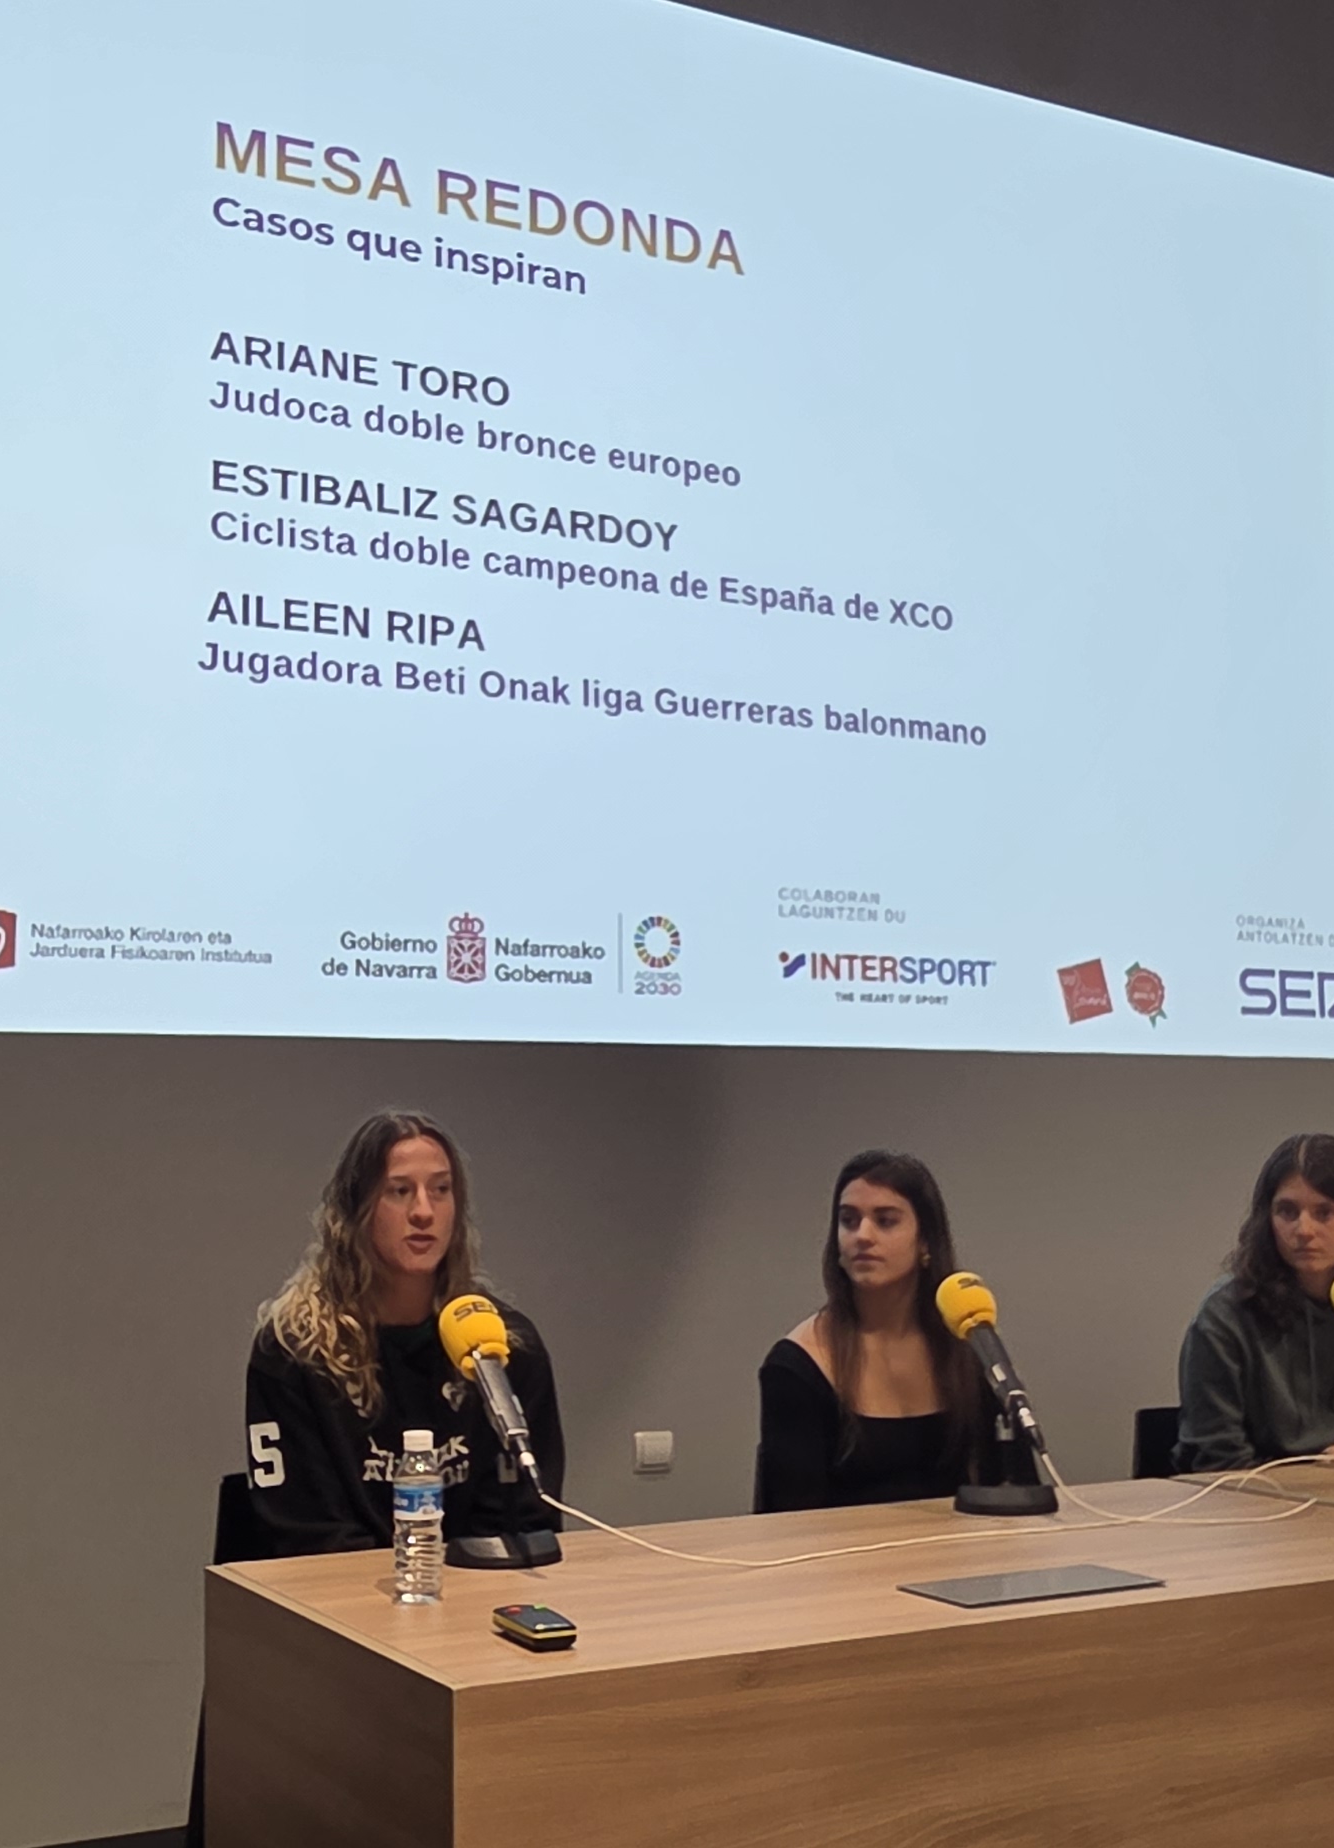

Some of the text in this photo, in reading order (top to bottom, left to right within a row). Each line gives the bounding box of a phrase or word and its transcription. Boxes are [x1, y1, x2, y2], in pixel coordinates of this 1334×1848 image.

[215, 120, 745, 276] MESA REDONDA
[212, 196, 586, 296] Casos que inspiran
[209, 331, 510, 407] ARIANE TORO
[208, 380, 741, 488] Judoca doble bronce europeo
[212, 459, 679, 553] ESTIBALIZ SAGARDOY
[210, 510, 954, 631] Ciclista doble campeona de España de XCO
[206, 590, 486, 652] AILEEN RIPA
[197, 641, 987, 746] Jugadora Beti Onak liga Guerreras balonmano
[777, 887, 881, 905] COLABORAN
[777, 904, 906, 924] LAGUNTZEN DU
[1235, 914, 1306, 930] ORGANIZA
[30, 923, 232, 945] Nafarroako Kirolaren eta
[339, 930, 438, 955] Gobierno
[1236, 929, 1325, 947] ANTOLATZEN
[29, 942, 273, 964] Jarduera Fisikoaren Institutua
[493, 937, 606, 962] Nafarroako
[321, 958, 438, 981] de Navarra
[493, 964, 593, 986] Gobernua
[810, 951, 993, 988] INTERSPORT
[633, 981, 682, 996] 2030
[835, 991, 949, 1006] THE HEART OF SPORT
[453, 1301, 498, 1322] SE
